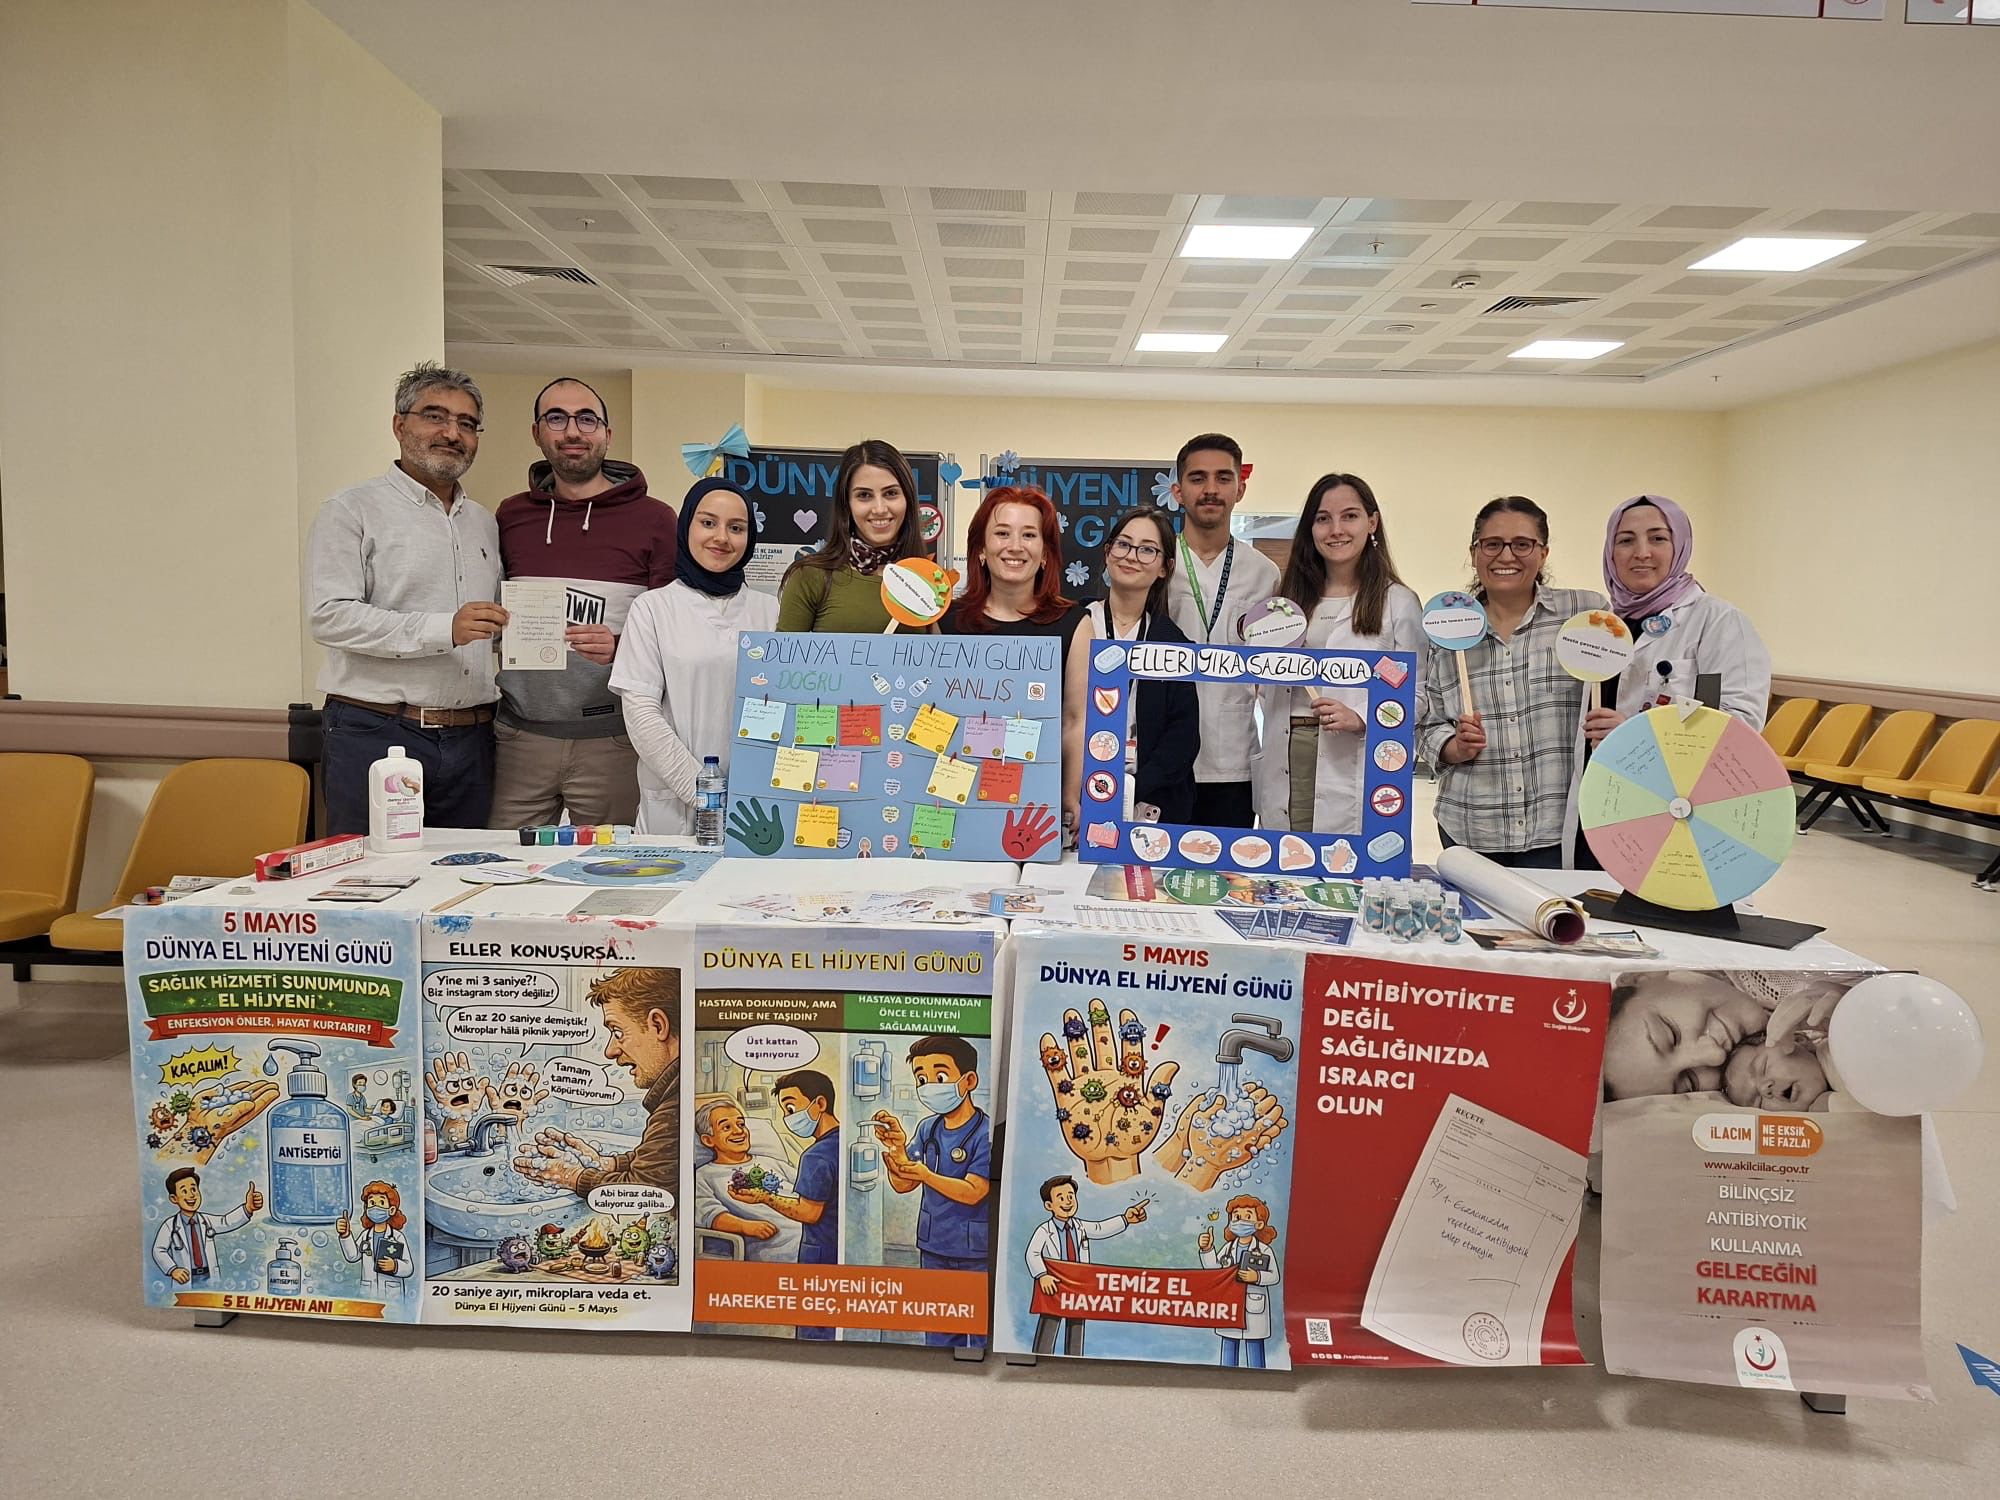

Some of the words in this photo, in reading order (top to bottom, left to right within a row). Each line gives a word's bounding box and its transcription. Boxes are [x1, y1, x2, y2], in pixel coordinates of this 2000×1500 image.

[727, 456, 840, 497] DÜNY
[762, 637, 838, 664] DÜNYA
[850, 640, 879, 666] EL
[892, 640, 979, 669] HİJYENİ
[985, 640, 1055, 671] GÜNÜ
[1199, 651, 1243, 672] YIKA
[1320, 661, 1368, 681] KOLLA
[776, 670, 842, 692] DOĞRU
[944, 677, 1014, 702] YANLIŞ
[224, 912, 236, 933] 5
[245, 913, 317, 934] MAYIS
[146, 936, 216, 960] DÜNYA
[223, 942, 247, 960] EL
[253, 937, 329, 962] HİJYENİ
[336, 941, 393, 964] GÜNÜ
[449, 942, 502, 957] ELLER
[511, 945, 636, 961] KONUŞURSA...
[1123, 944, 1136, 961] 5
[1144, 946, 1210, 967] MAYIS
[704, 947, 783, 969] DÜNYA
[791, 952, 815, 969] EL
[822, 949, 905, 971] HİJYENİ
[913, 951, 983, 974] GÜNÜ
[148, 975, 205, 993] SAĞLIK
[211, 973, 277, 989] HİZMETİ
[282, 974, 391, 997] SUNUMUNDA
[437, 976, 462, 986] Yine
[466, 976, 479, 985] mi
[483, 976, 490, 985] 3
[493, 975, 537, 988] saniye?!
[1040, 961, 1111, 986] DÜNYA
[1117, 971, 1139, 988] EL
[1146, 970, 1227, 995] HİJYENİ
[1232, 979, 1293, 1000] GÜNÜ
[218, 993, 239, 1008] EL
[244, 994, 316, 1009] HİJYENİ
[428, 987, 443, 997] Biz
[446, 988, 492, 999] instagram
[495, 989, 519, 999] story
[522, 988, 554, 999] değiliz!
[858, 995, 903, 1004] HASTAYA
[905, 997, 982, 1007] DOKUNMADAN
[1325, 978, 1515, 1014] ANTİBİYOTİKTE
[699, 1000, 744, 1008] HASTAYA
[746, 1000, 810, 1010] DOKUNDUN,
[811, 1000, 837, 1009] AMA
[879, 1007, 907, 1017] ÖNCE
[910, 1009, 921, 1018] EL
[922, 1009, 961, 1019] HİJYENİ
[168, 1015, 234, 1029] ENFEKSİYON
[236, 1015, 273, 1028] ÖNLER,
[277, 1018, 310, 1028] HAYAT
[313, 1019, 372, 1035] KURTARIR!
[458, 1013, 472, 1021] En
[491, 1013, 506, 1022] 20
[509, 1015, 541, 1025] saniye
[544, 1015, 587, 1027] demiştik!
[719, 1010, 754, 1020] ELİNDE
[757, 1012, 770, 1020] NE
[772, 1012, 818, 1023] TAŞIDIN?
[1323, 1007, 1394, 1031] DEĞİL
[454, 1025, 498, 1037] Mikroplar
[522, 1027, 550, 1037] piknik
[552, 1029, 589, 1039] yapıyor!
[879, 1021, 959, 1033] SAĞLAMALIYIM.
[747, 1036, 763, 1045] Üst
[766, 1037, 798, 1046] kattan
[745, 1050, 799, 1061] taşınıyoruz
[1321, 1035, 1489, 1068] SAĞLIĞINIZDA
[170, 1055, 229, 1078] KAÇALIM!
[554, 1062, 591, 1076] Tamam
[551, 1073, 592, 1087] tamam!
[1319, 1066, 1415, 1090] ISRARCI
[551, 1086, 615, 1101] Köpürtüyorum!
[1317, 1095, 1383, 1116] OLUN
[1455, 1107, 1485, 1125] REÇETE
[303, 1134, 318, 1144] EL
[1710, 1126, 1752, 1141] İLACIM
[1762, 1124, 1776, 1135] NE
[1778, 1125, 1805, 1137] EKSİK
[1762, 1136, 1776, 1147] NE
[1778, 1137, 1810, 1149] FAZLA!
[1704, 1160, 1810, 1175] www.akilciilac.gov.tr
[600, 1189, 616, 1198] Abi
[618, 1189, 639, 1198] biraz
[642, 1190, 663, 1199] daha
[1719, 1183, 1795, 1205] BİLİNÇSİZ
[594, 1200, 635, 1209] kalıyoruz
[637, 1200, 671, 1209] galiba..
[1453, 1200, 1510, 1232] Eczacınızdan
[1707, 1210, 1808, 1230] ANTİBİYOTİK
[1441, 1229, 1460, 1247] talep
[1447, 1217, 1484, 1237] reçetesiz
[1485, 1234, 1529, 1257] antibiyotik
[1711, 1238, 1802, 1256] KULLANMA
[1696, 1260, 1818, 1286] GELECEĞİNİ
[778, 1277, 798, 1291] EL
[803, 1275, 866, 1293] HİJYENİ
[871, 1277, 902, 1297] İÇİN
[1096, 1271, 1160, 1294] TEMİZ
[1167, 1278, 1192, 1296] EL
[432, 1286, 450, 1296] 20
[454, 1288, 492, 1300] saniye
[495, 1288, 522, 1301] ayır,
[525, 1288, 593, 1302] mikroplara
[597, 1289, 628, 1299] veda
[633, 1290, 652, 1300] et.
[1697, 1287, 1817, 1312] KARARTMA
[223, 1295, 232, 1307] 5
[236, 1297, 251, 1308] EL
[256, 1297, 305, 1311] HİJYENİ
[308, 1300, 333, 1313] ANI
[455, 1302, 486, 1313] Dünya
[490, 1302, 498, 1311] El
[502, 1302, 536, 1313] Hijyeni
[539, 1303, 566, 1312] Günü
[578, 1305, 585, 1313] 5
[588, 1305, 618, 1315] Mayıs
[708, 1293, 797, 1310] HAREKETE
[802, 1297, 841, 1315] GEÇ,
[846, 1299, 898, 1314] HAYAT
[902, 1302, 975, 1318] KURTAR!
[1060, 1293, 1125, 1312] HAYAT
[1131, 1298, 1238, 1321] KURTARIR!
